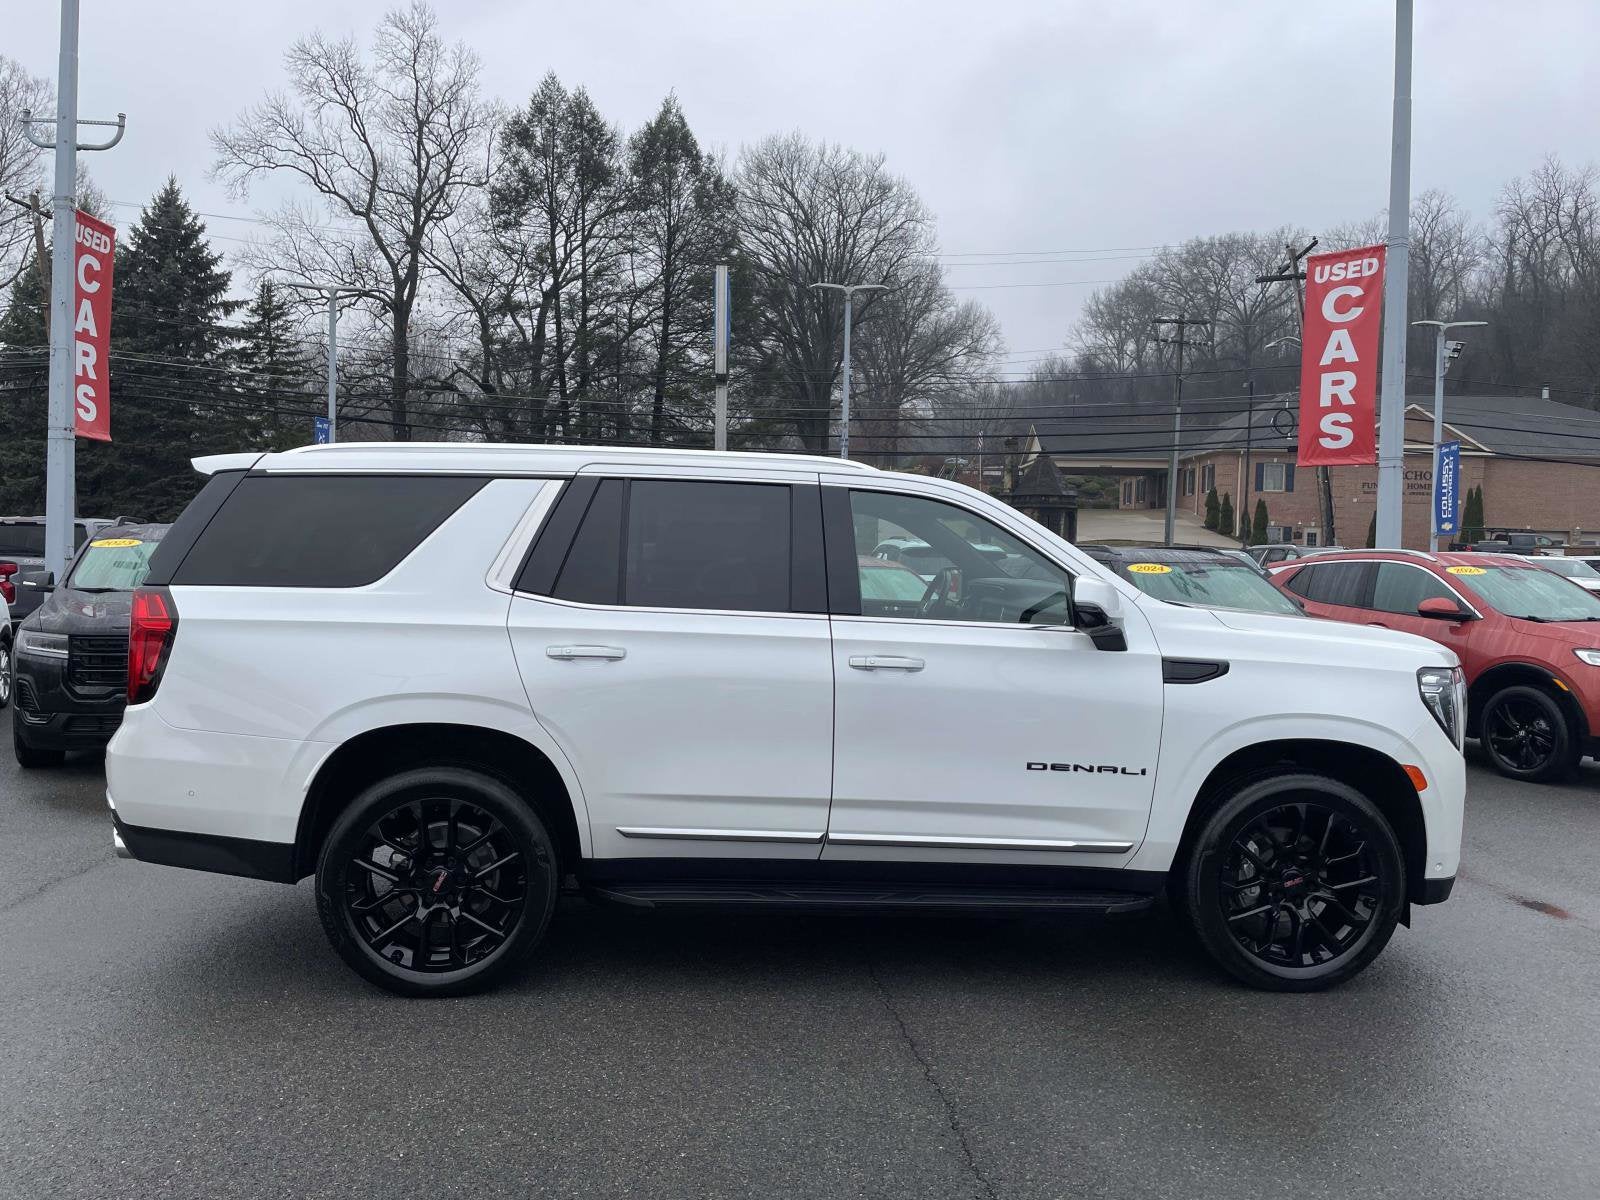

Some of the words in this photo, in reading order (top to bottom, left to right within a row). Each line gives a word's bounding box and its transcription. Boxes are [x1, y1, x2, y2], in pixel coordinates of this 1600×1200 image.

[75, 222, 111, 254] USED
[1314, 257, 1380, 284] USED
[75, 254, 101, 422] CARS
[1318, 285, 1365, 450] CARS
[1441, 456, 1450, 519] COLUSSY
[1026, 761, 1147, 776] DENALI
